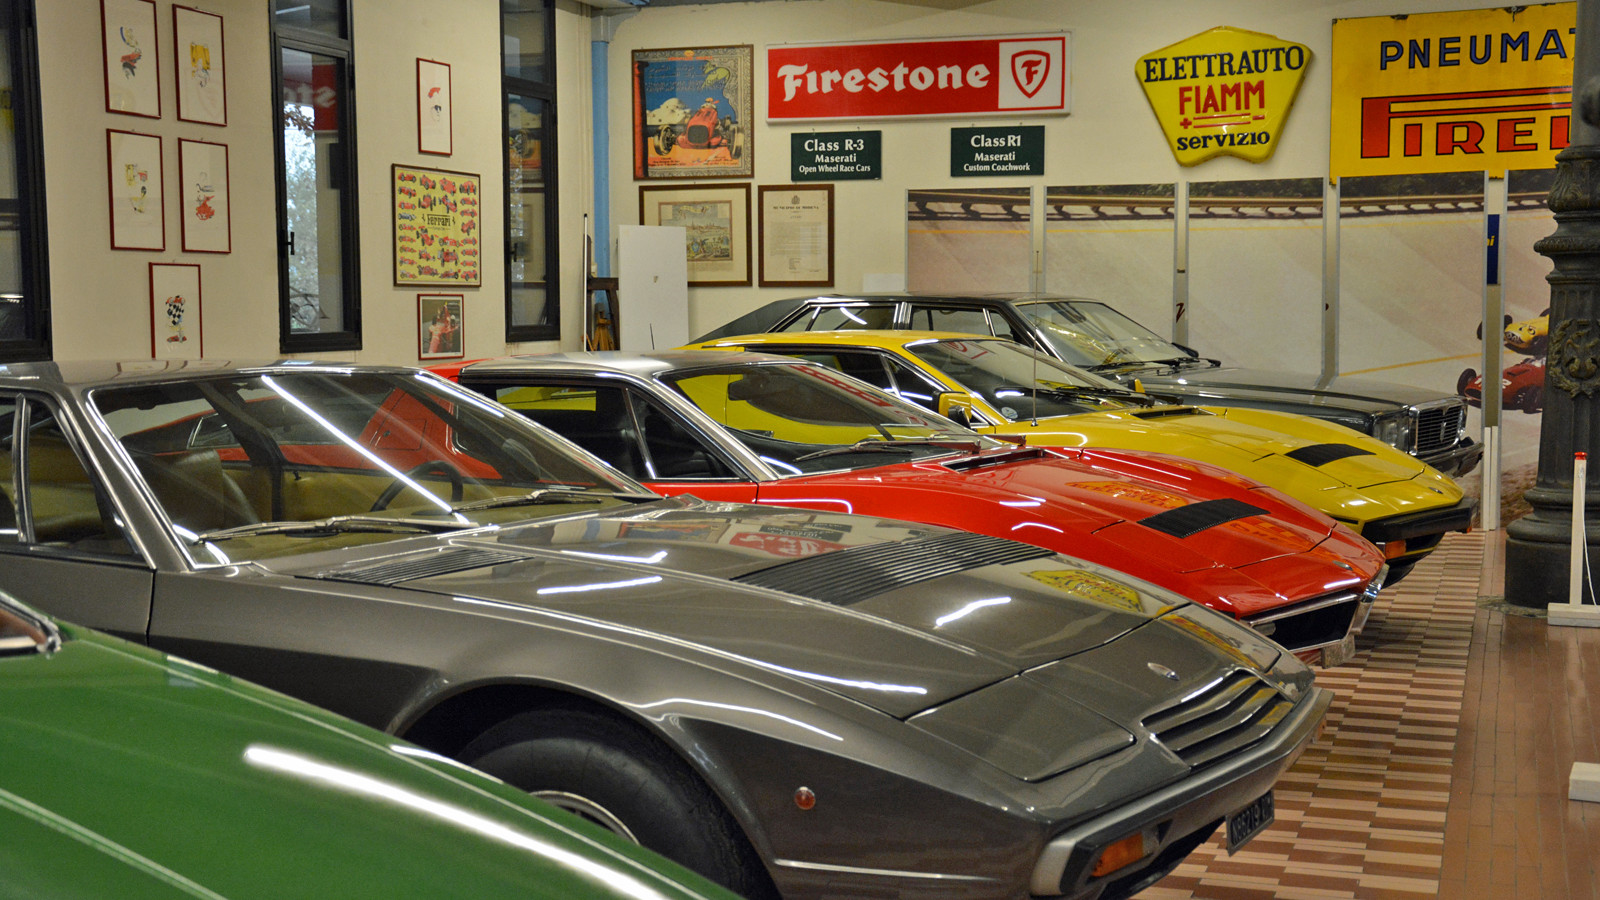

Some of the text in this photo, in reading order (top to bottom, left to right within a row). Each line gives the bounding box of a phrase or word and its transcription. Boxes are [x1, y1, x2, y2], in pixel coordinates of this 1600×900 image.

[1380, 28, 1576, 71] PNEUMA
[1144, 45, 1305, 83] ELETTRAUTO
[777, 61, 991, 102] Firestone
[1179, 79, 1265, 115] FIAMM
[804, 138, 865, 152] Class R-3
[971, 134, 1021, 148] Class R1
[1177, 131, 1270, 151] servizio
[815, 153, 857, 163] Maserati
[974, 151, 1016, 162] Maserati
[799, 163, 871, 175] Open Wheel Race Cars
[963, 162, 1031, 172] Custom Coachwork
[427, 213, 451, 226] Ferrari
